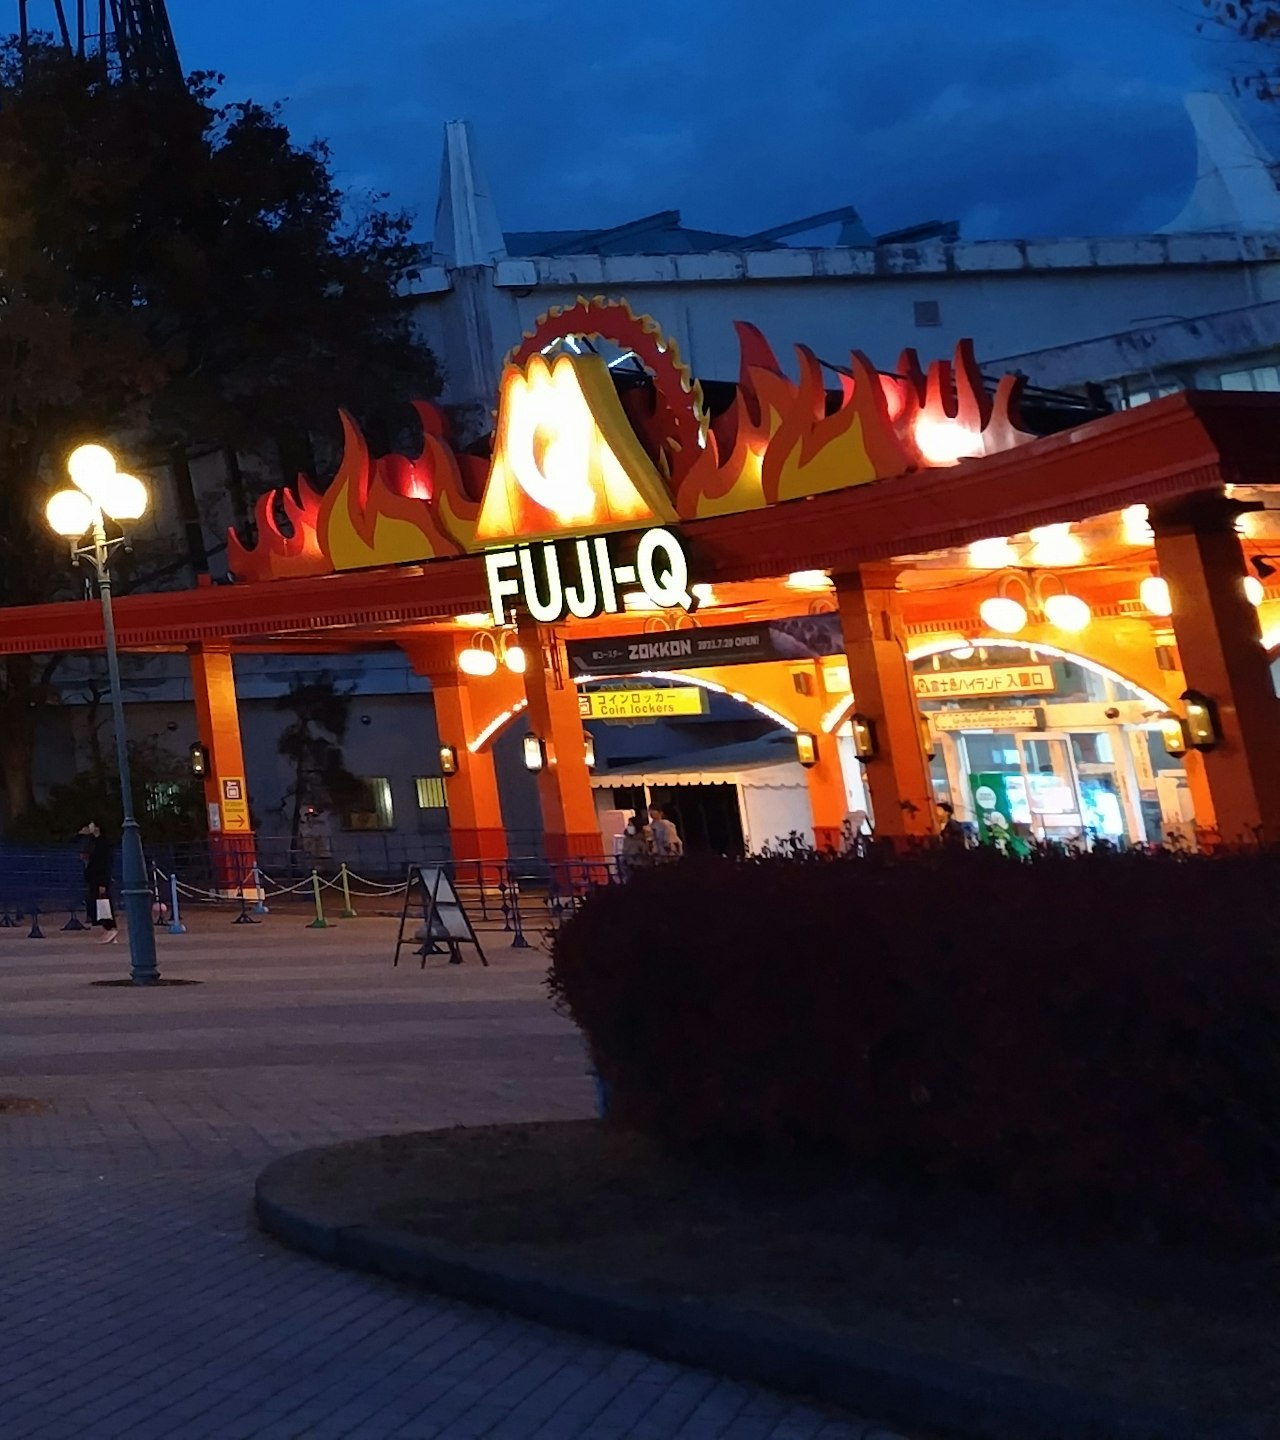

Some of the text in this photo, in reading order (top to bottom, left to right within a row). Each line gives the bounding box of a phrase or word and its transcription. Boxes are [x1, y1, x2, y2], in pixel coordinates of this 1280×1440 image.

[485, 527, 693, 626] FUJI-Q
[628, 639, 692, 660] ZOKKON
[597, 693, 676, 705] コインロッカー
[601, 703, 675, 715] Coin lockers
